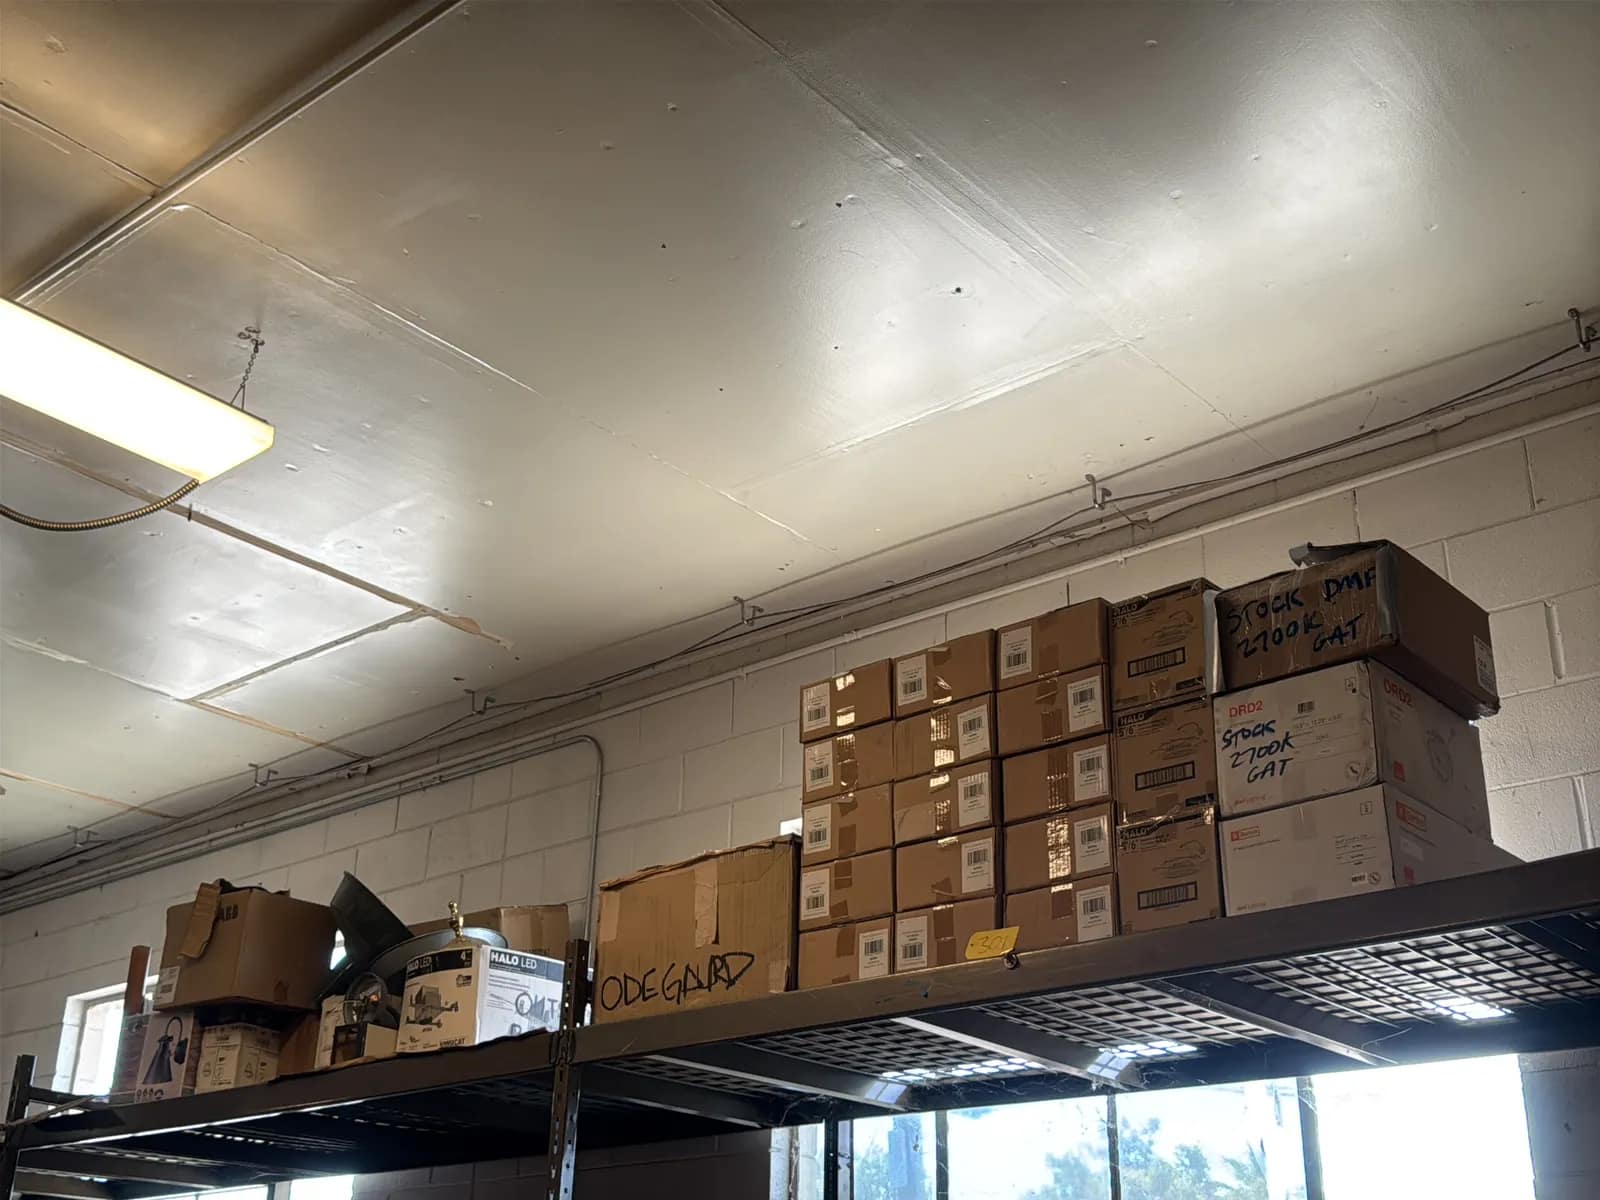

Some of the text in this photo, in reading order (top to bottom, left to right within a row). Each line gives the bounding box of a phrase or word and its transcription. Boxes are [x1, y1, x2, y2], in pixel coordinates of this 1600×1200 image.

[1226, 588, 1304, 635] STOCK
[1236, 610, 1323, 659] 2700K
[1313, 612, 1365, 652] GAT
[1384, 678, 1413, 706] DRD2
[1120, 712, 1145, 726] HALO
[1229, 700, 1265, 718] DRD2
[1222, 720, 1276, 750] STOCK
[1230, 731, 1295, 769] 2700K
[1247, 757, 1294, 784] GAT
[491, 951, 519, 966] HALO
[521, 956, 537, 970] LED
